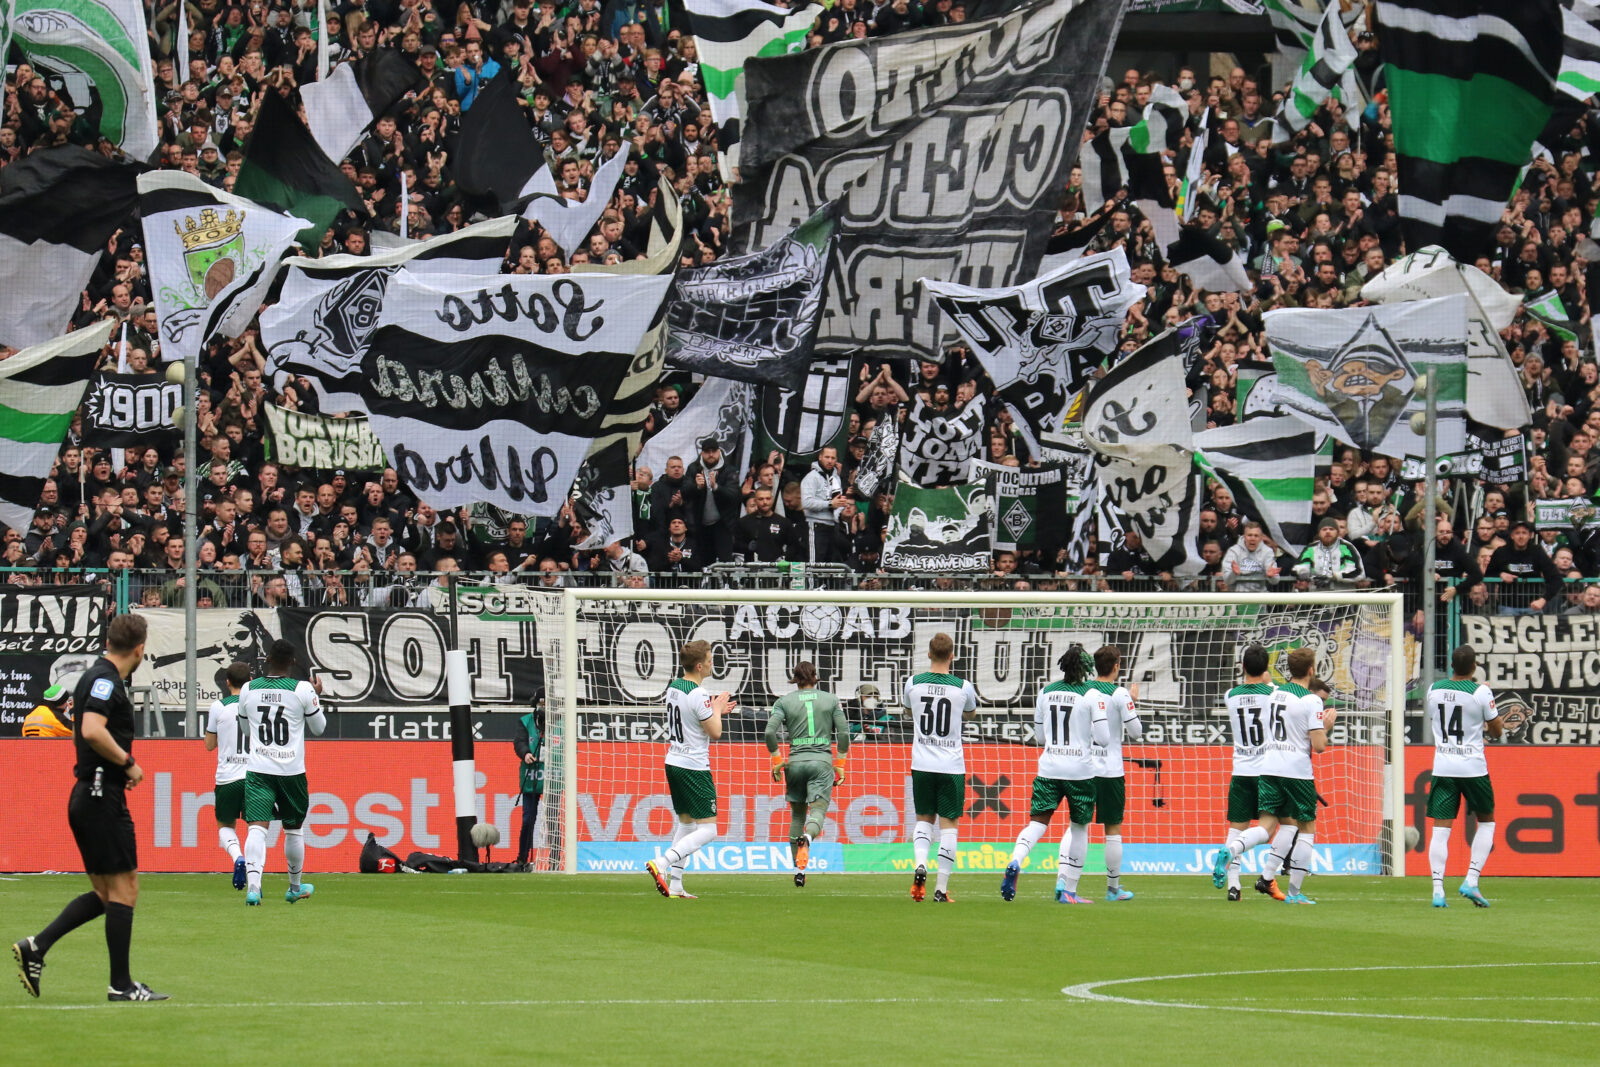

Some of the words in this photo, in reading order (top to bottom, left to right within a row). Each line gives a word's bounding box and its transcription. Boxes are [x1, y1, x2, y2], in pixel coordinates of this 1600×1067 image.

[101, 384, 184, 432] 1900
[275, 433, 383, 469] BORUSSIA
[976, 465, 1062, 487] SOTOCULTURA
[884, 553, 990, 572] GEWALTANWENDER
[40, 637, 100, 653] 2006
[1461, 614, 1600, 654] BEGLE
[152, 678, 200, 690] rabaue
[178, 688, 223, 700] biben
[257, 706, 289, 746] 36
[368, 714, 484, 740] flatx
[577, 715, 671, 741] latex
[804, 701, 815, 736] 1
[920, 696, 951, 737] 30
[961, 717, 1036, 743] atex
[1049, 704, 1073, 745] 17
[1236, 707, 1264, 747] 13
[1269, 702, 1288, 742] 15
[1438, 703, 1464, 745] 14
[1136, 721, 1227, 745] atex
[153, 771, 441, 848] Inest
[588, 859, 638, 871] www.
[650, 846, 795, 871] JNGEN
[1130, 862, 1181, 874] www.
[1341, 861, 1369, 874] .de
